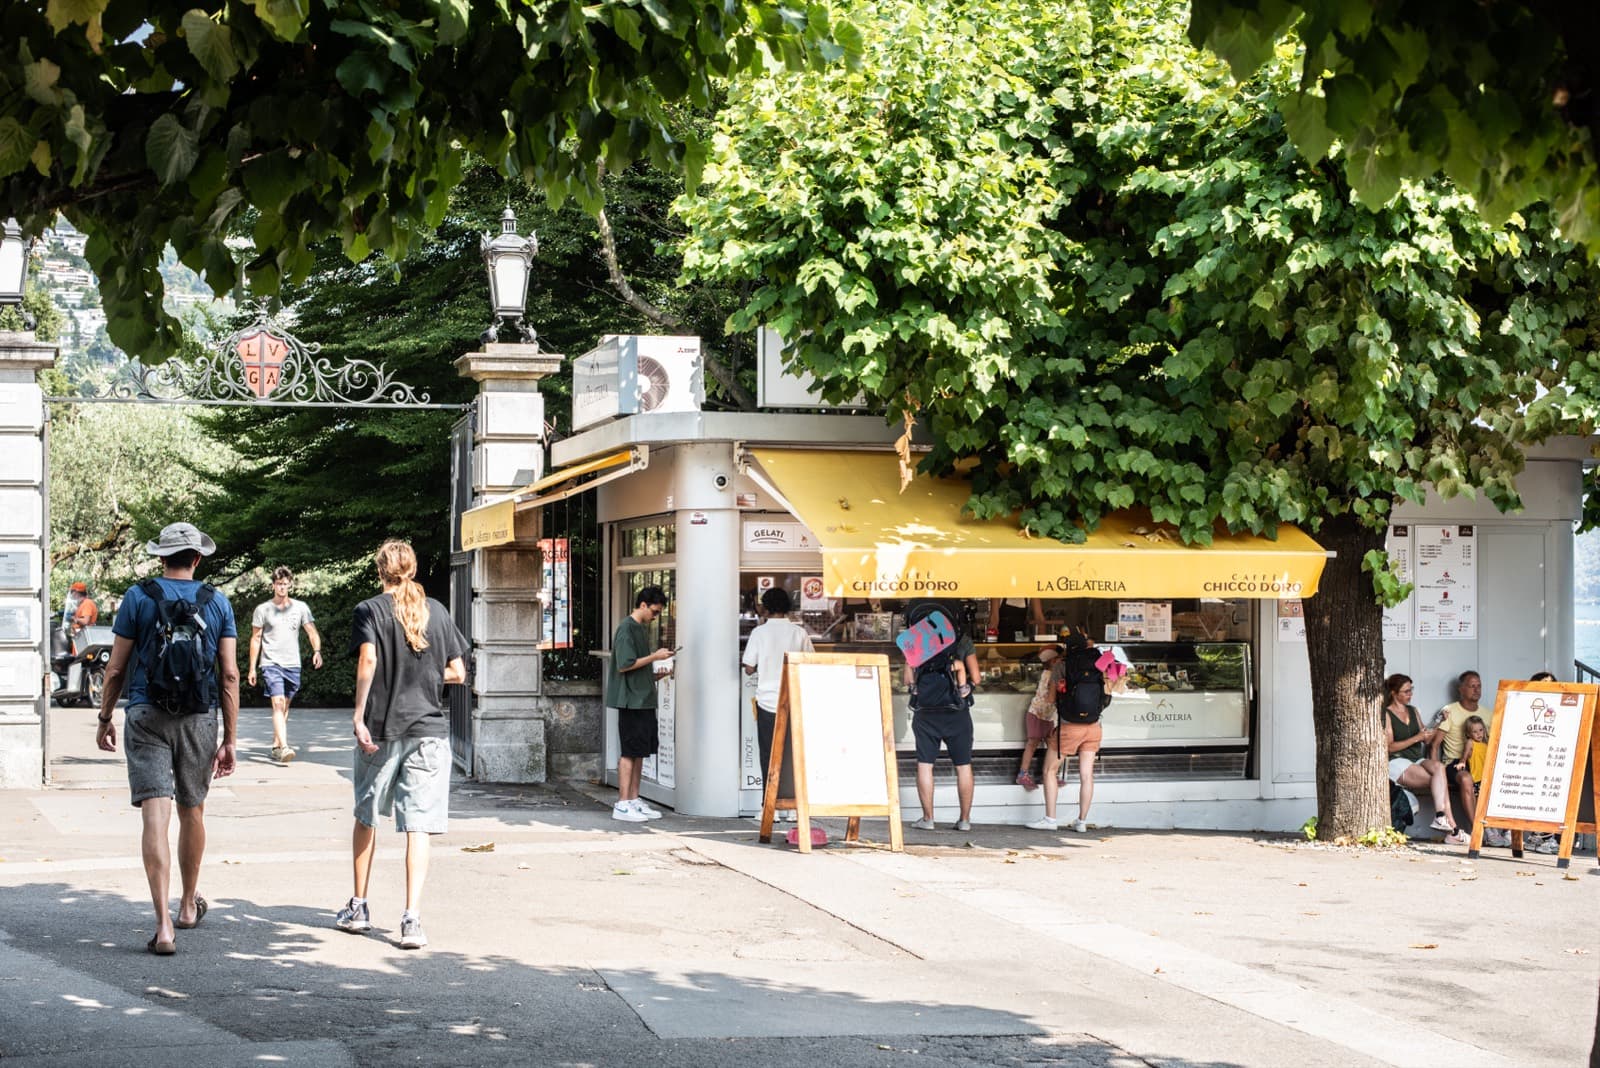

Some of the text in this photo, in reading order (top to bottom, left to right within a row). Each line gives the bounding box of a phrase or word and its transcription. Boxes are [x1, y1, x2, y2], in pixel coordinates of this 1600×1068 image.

[247, 343, 279, 356] L V
[249, 371, 276, 384] G A
[753, 528, 785, 539] GELATI
[852, 580, 909, 592] CHICCO
[1037, 580, 1055, 592] LA
[1203, 581, 1257, 592] CHICCO
[1133, 714, 1146, 722] LA
[1526, 723, 1556, 734] GELATI
